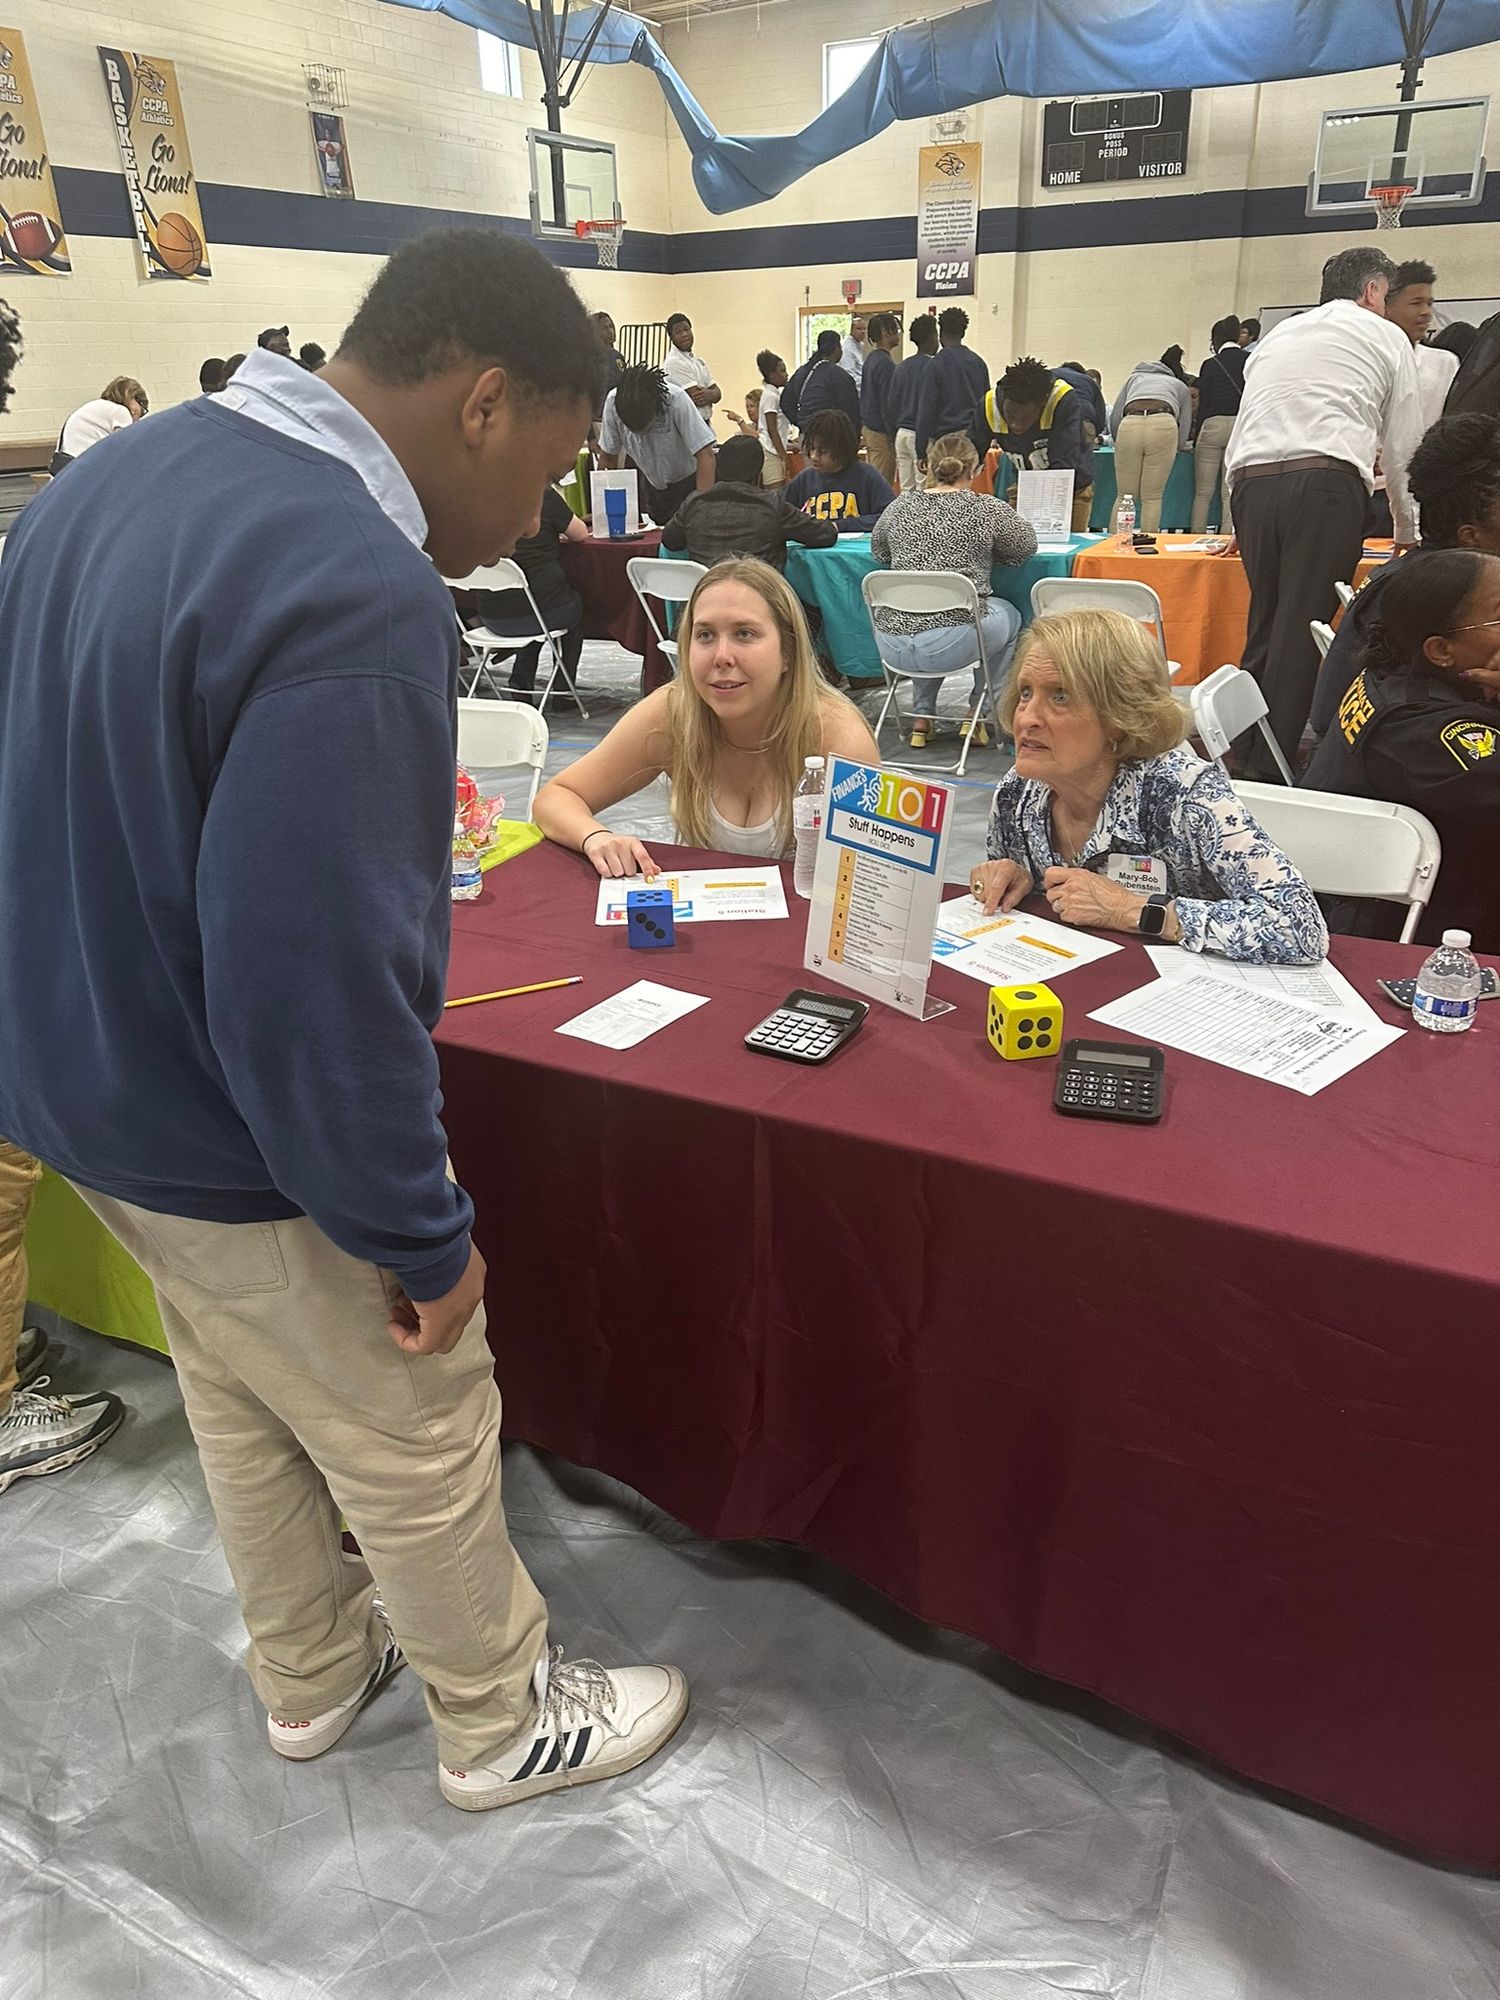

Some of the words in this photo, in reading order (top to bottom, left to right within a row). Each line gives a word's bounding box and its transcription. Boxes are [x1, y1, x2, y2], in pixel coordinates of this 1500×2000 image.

[0, 74, 16, 90] PA
[142, 97, 168, 113] CCPA
[141, 112, 174, 126] Athletics
[0, 112, 25, 145] Go
[1104, 132, 1125, 140] BONUS
[151, 134, 175, 162] Go
[1105, 140, 1122, 148] POSS
[1098, 147, 1128, 159] PERIOD
[0, 150, 48, 180] ions!
[105, 58, 155, 273] BASKETBALL
[1139, 162, 1182, 177] VISITOR
[144, 165, 193, 194] Lions!
[1049, 171, 1081, 185] HOME
[925, 262, 969, 280] CCPA
[935, 282, 957, 290] Vision
[832, 768, 867, 802] FINANCES
[848, 817, 870, 831] Stuff
[871, 824, 916, 848] Happens
[1119, 872, 1159, 884] Mary-Bob
